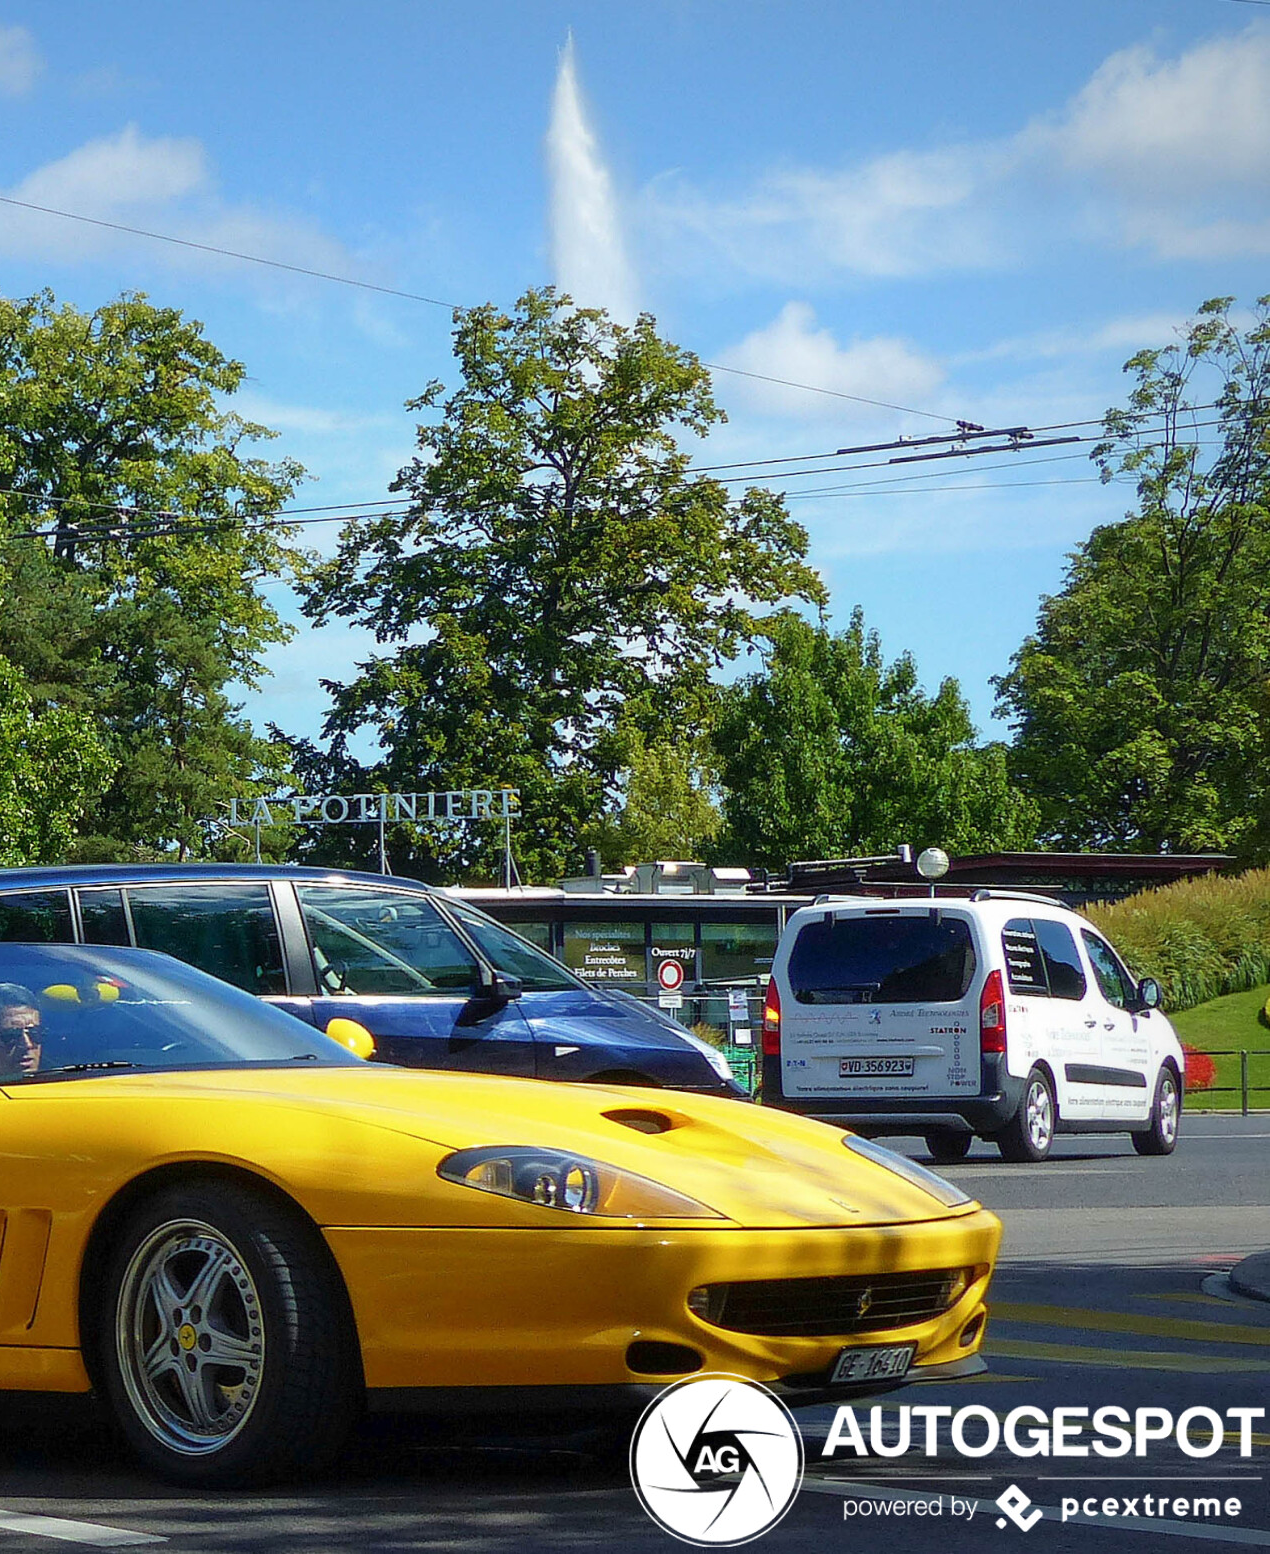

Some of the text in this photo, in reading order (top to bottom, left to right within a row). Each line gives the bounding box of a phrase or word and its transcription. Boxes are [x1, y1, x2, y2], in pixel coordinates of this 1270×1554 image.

[230, 798, 274, 827] LA
[651, 947, 679, 957] Ouvert
[574, 967, 637, 978] Filets de Perches
